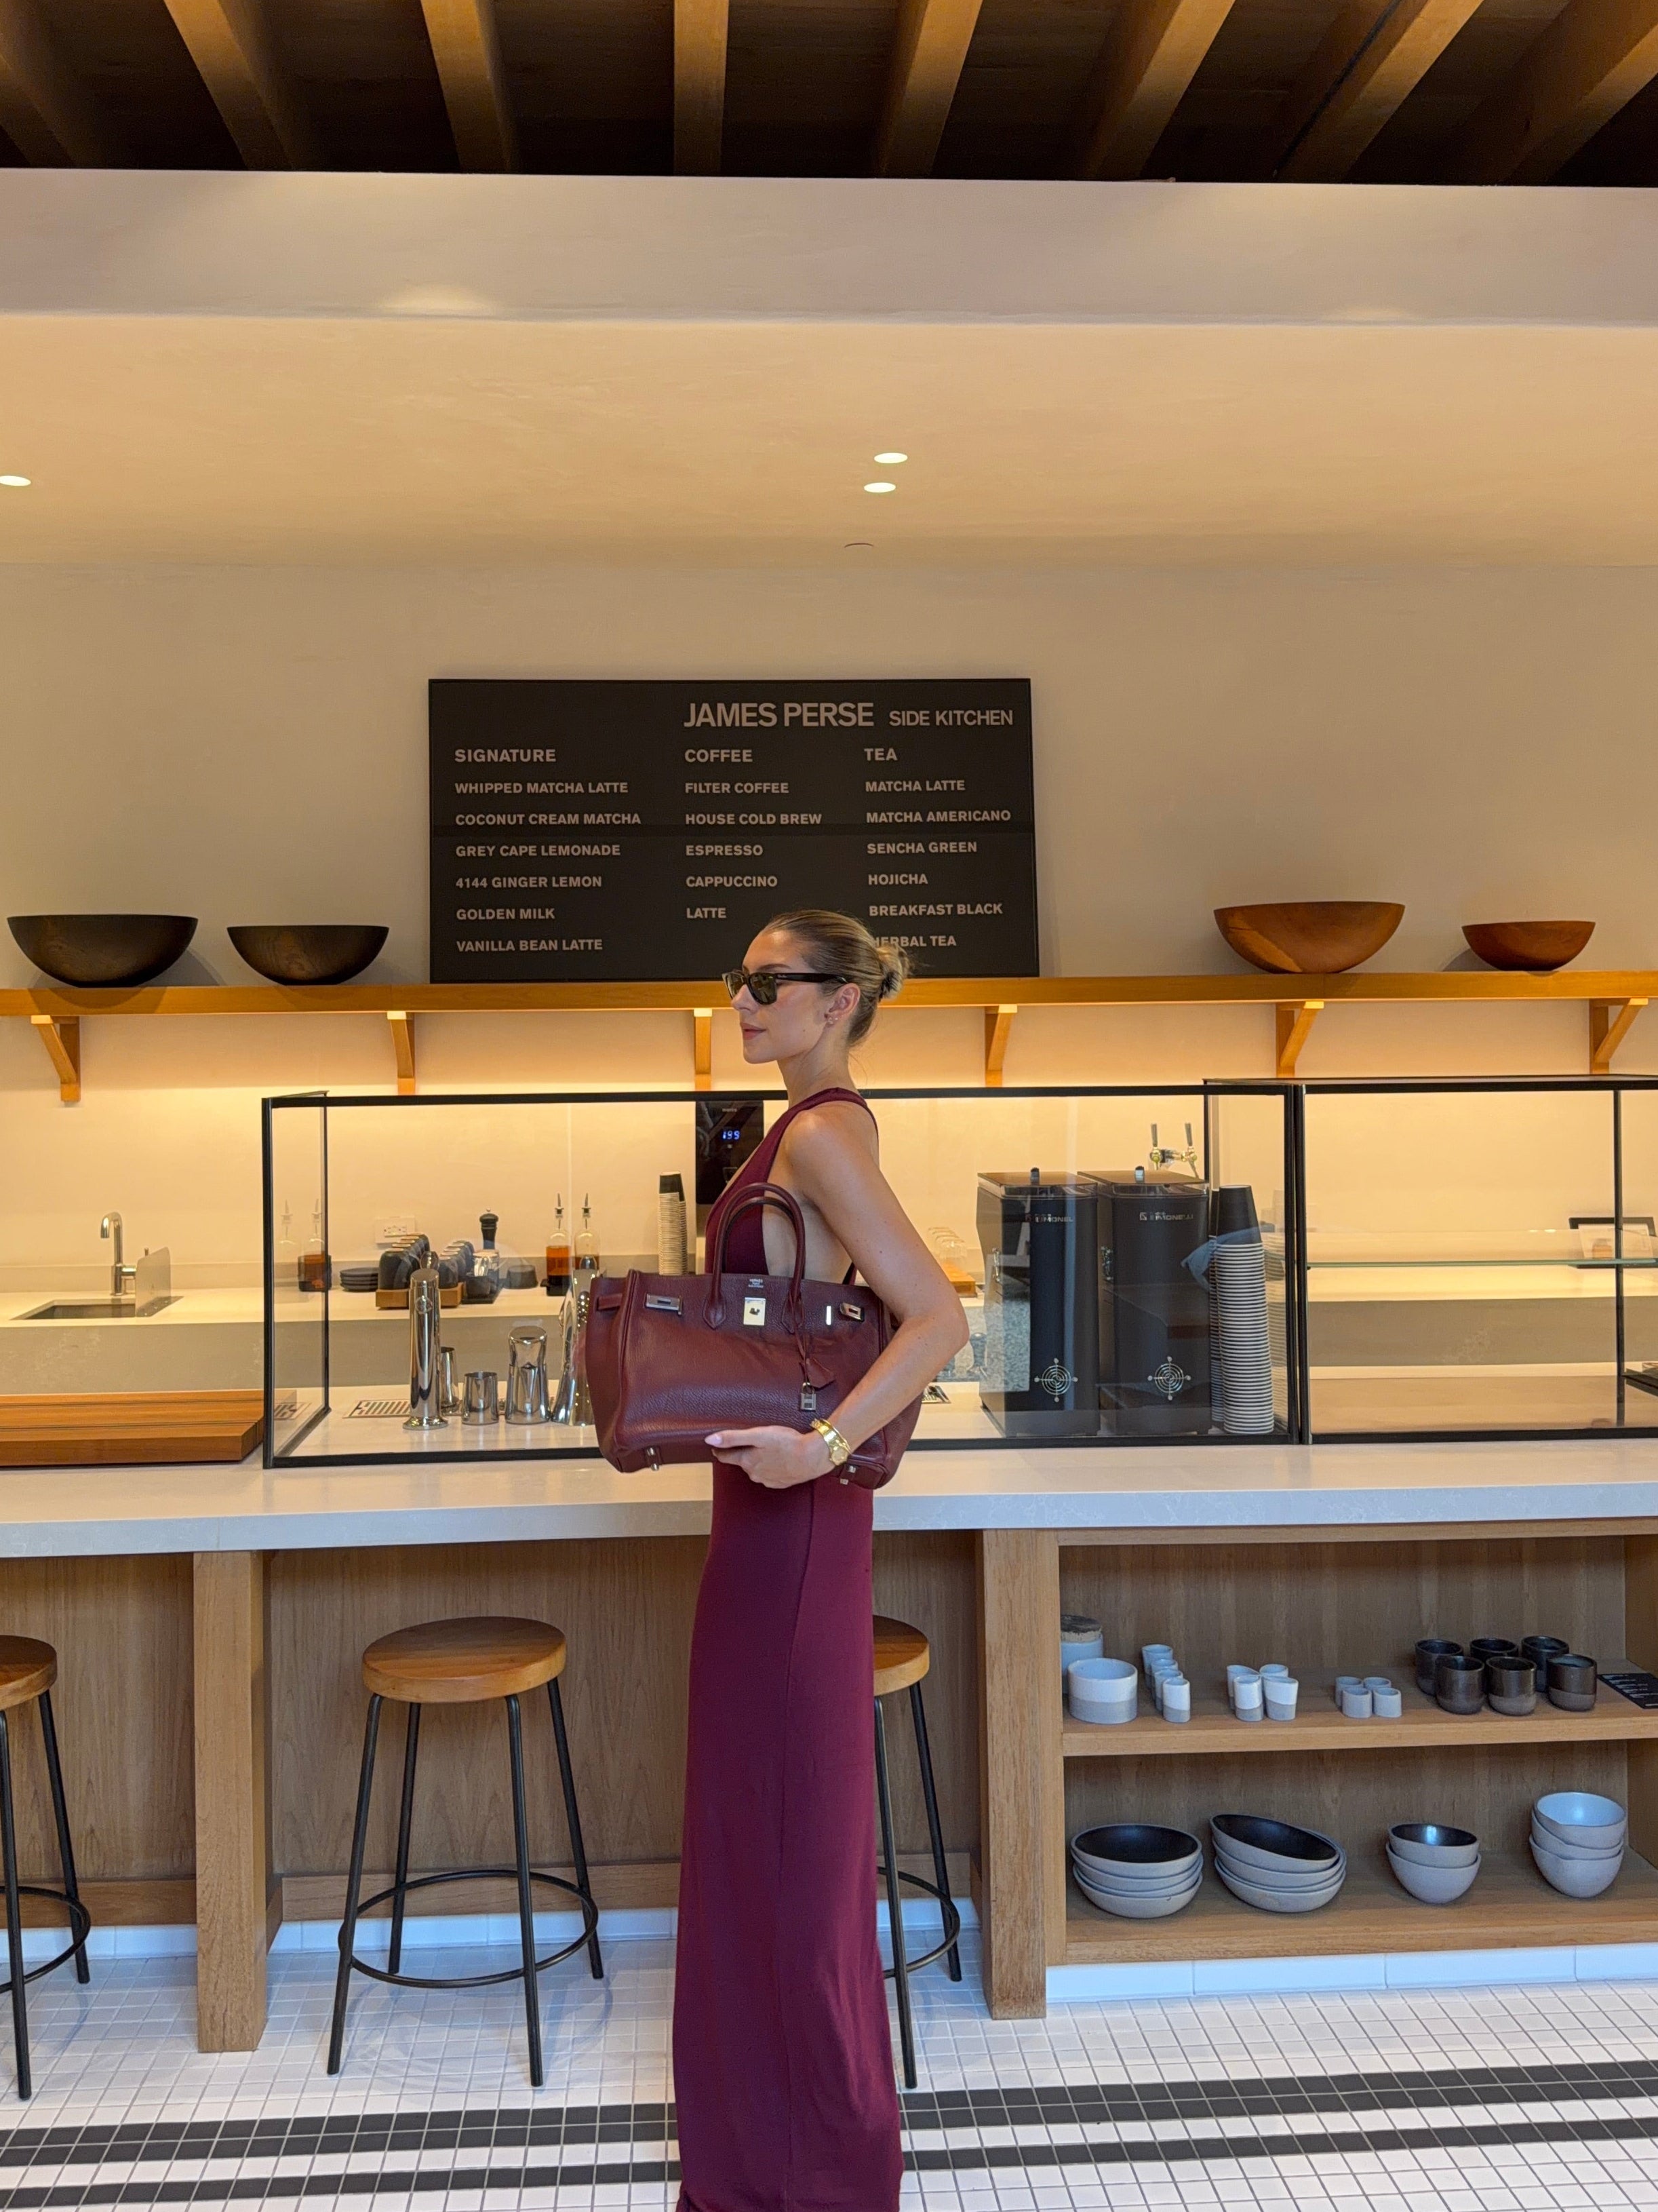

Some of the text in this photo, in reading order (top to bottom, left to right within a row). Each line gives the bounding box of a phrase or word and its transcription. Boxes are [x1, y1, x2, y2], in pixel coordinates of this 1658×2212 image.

[684, 702, 1013, 727] JAMES PERSE SIDE KITCHEN
[454, 748, 556, 762] SIGNATURE
[684, 749, 753, 762] COFFEE
[863, 748, 898, 761] TEA
[454, 782, 629, 794] WHIPPED MATCHA LATTE
[685, 782, 789, 794] FILTER COFFEE
[865, 779, 966, 792] MATCHA LATTE
[455, 813, 642, 826] COCONUT CREAM MATCHA
[686, 813, 822, 825] HOUSE COLD BREW
[866, 810, 1011, 823] MATCHA AMERICANO
[456, 845, 621, 857] GREY CAPE LEMONADE
[686, 845, 764, 856] ESPRESSO
[867, 842, 977, 855] SENCHA GREEN
[456, 876, 602, 889] 4144 GINGER LEMON
[686, 876, 778, 887] CAPPUCCINO
[868, 873, 928, 885] HOJICHA
[456, 908, 555, 920] GOLDEN MILK
[686, 907, 727, 918] LATTE
[869, 903, 1003, 916] BREAKFAST BLACK
[456, 939, 603, 952] VANILLA BEAN LATTE
[930, 935, 957, 947] TEA
